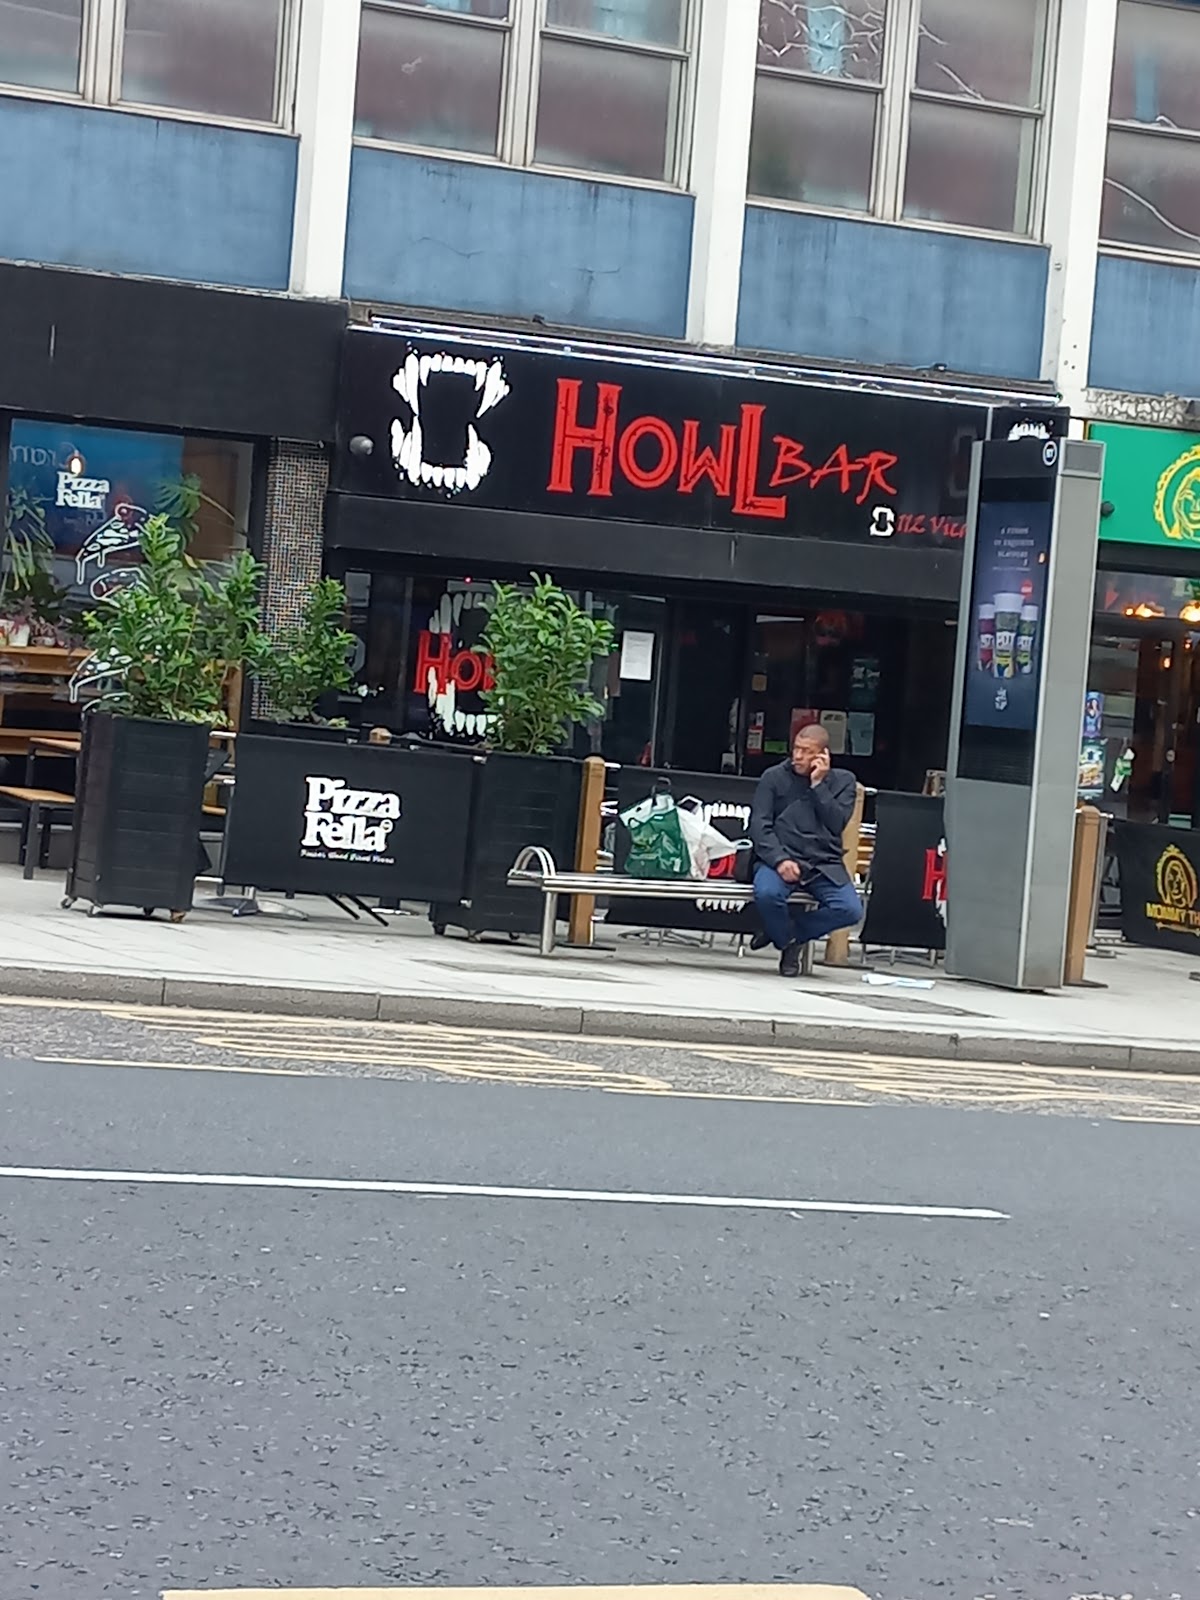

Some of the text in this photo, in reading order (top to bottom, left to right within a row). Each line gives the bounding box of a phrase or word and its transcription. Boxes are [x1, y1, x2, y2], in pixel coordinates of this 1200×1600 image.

[57, 471, 110, 493] Pizza
[769, 435, 897, 505] BAR
[55, 488, 106, 509] Fella
[305, 776, 401, 819] Pizza
[301, 811, 388, 852] Fella
